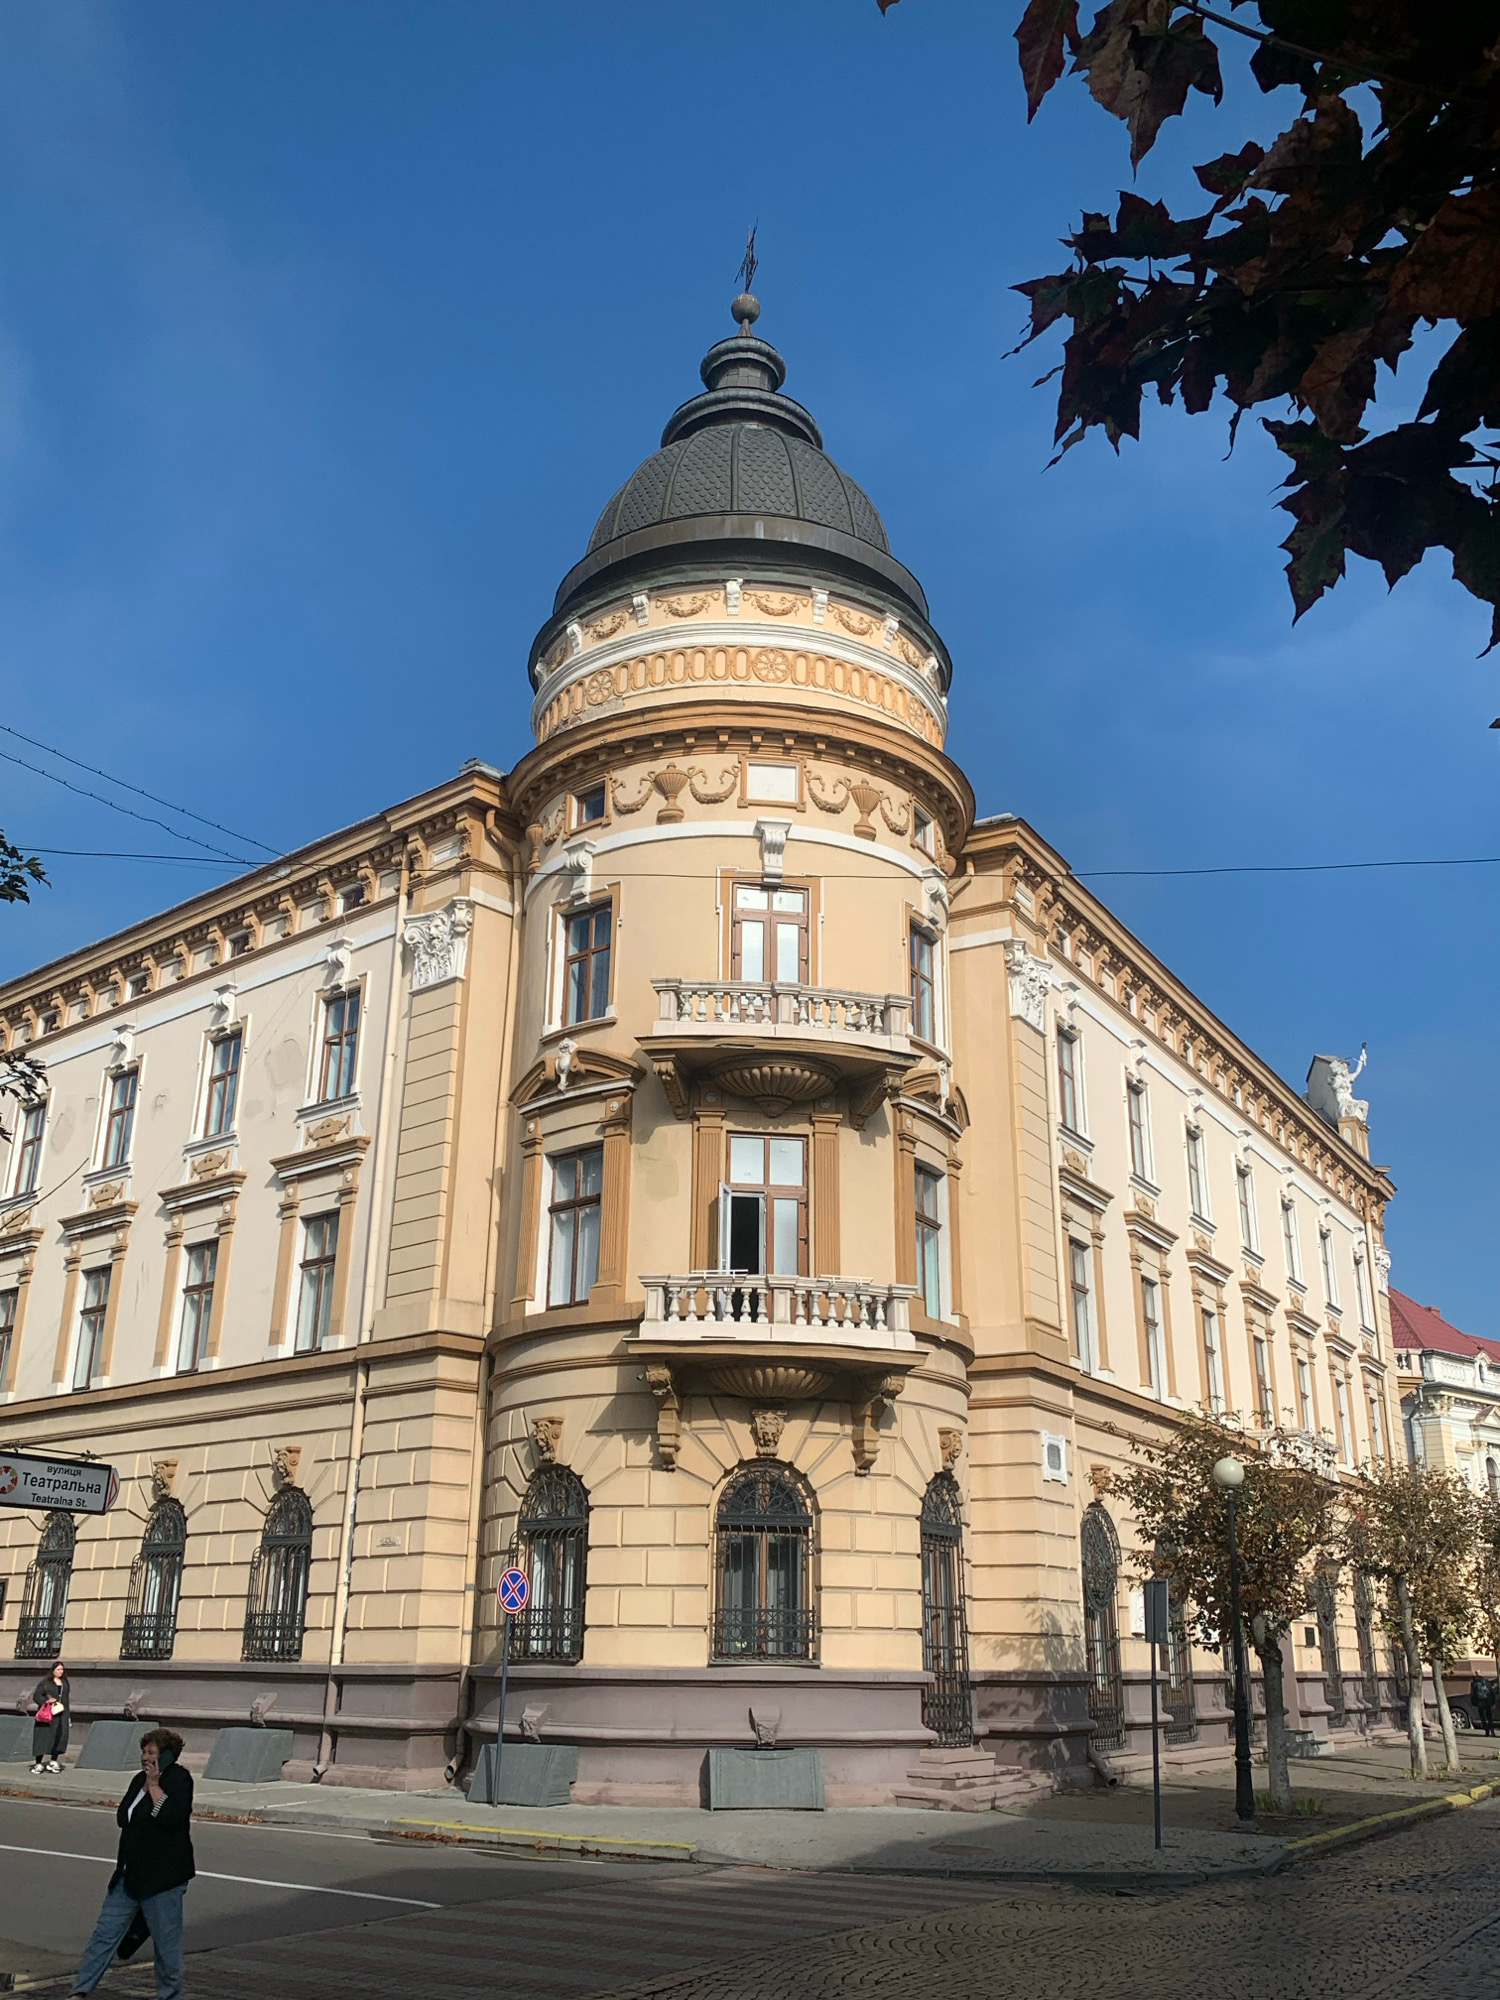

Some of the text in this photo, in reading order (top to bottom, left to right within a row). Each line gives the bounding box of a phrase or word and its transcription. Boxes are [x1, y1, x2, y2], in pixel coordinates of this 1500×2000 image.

[47, 1465, 82, 1477] вулиця
[22, 1472, 101, 1495] Театральна
[31, 1493, 88, 1508] Teatralna St.
